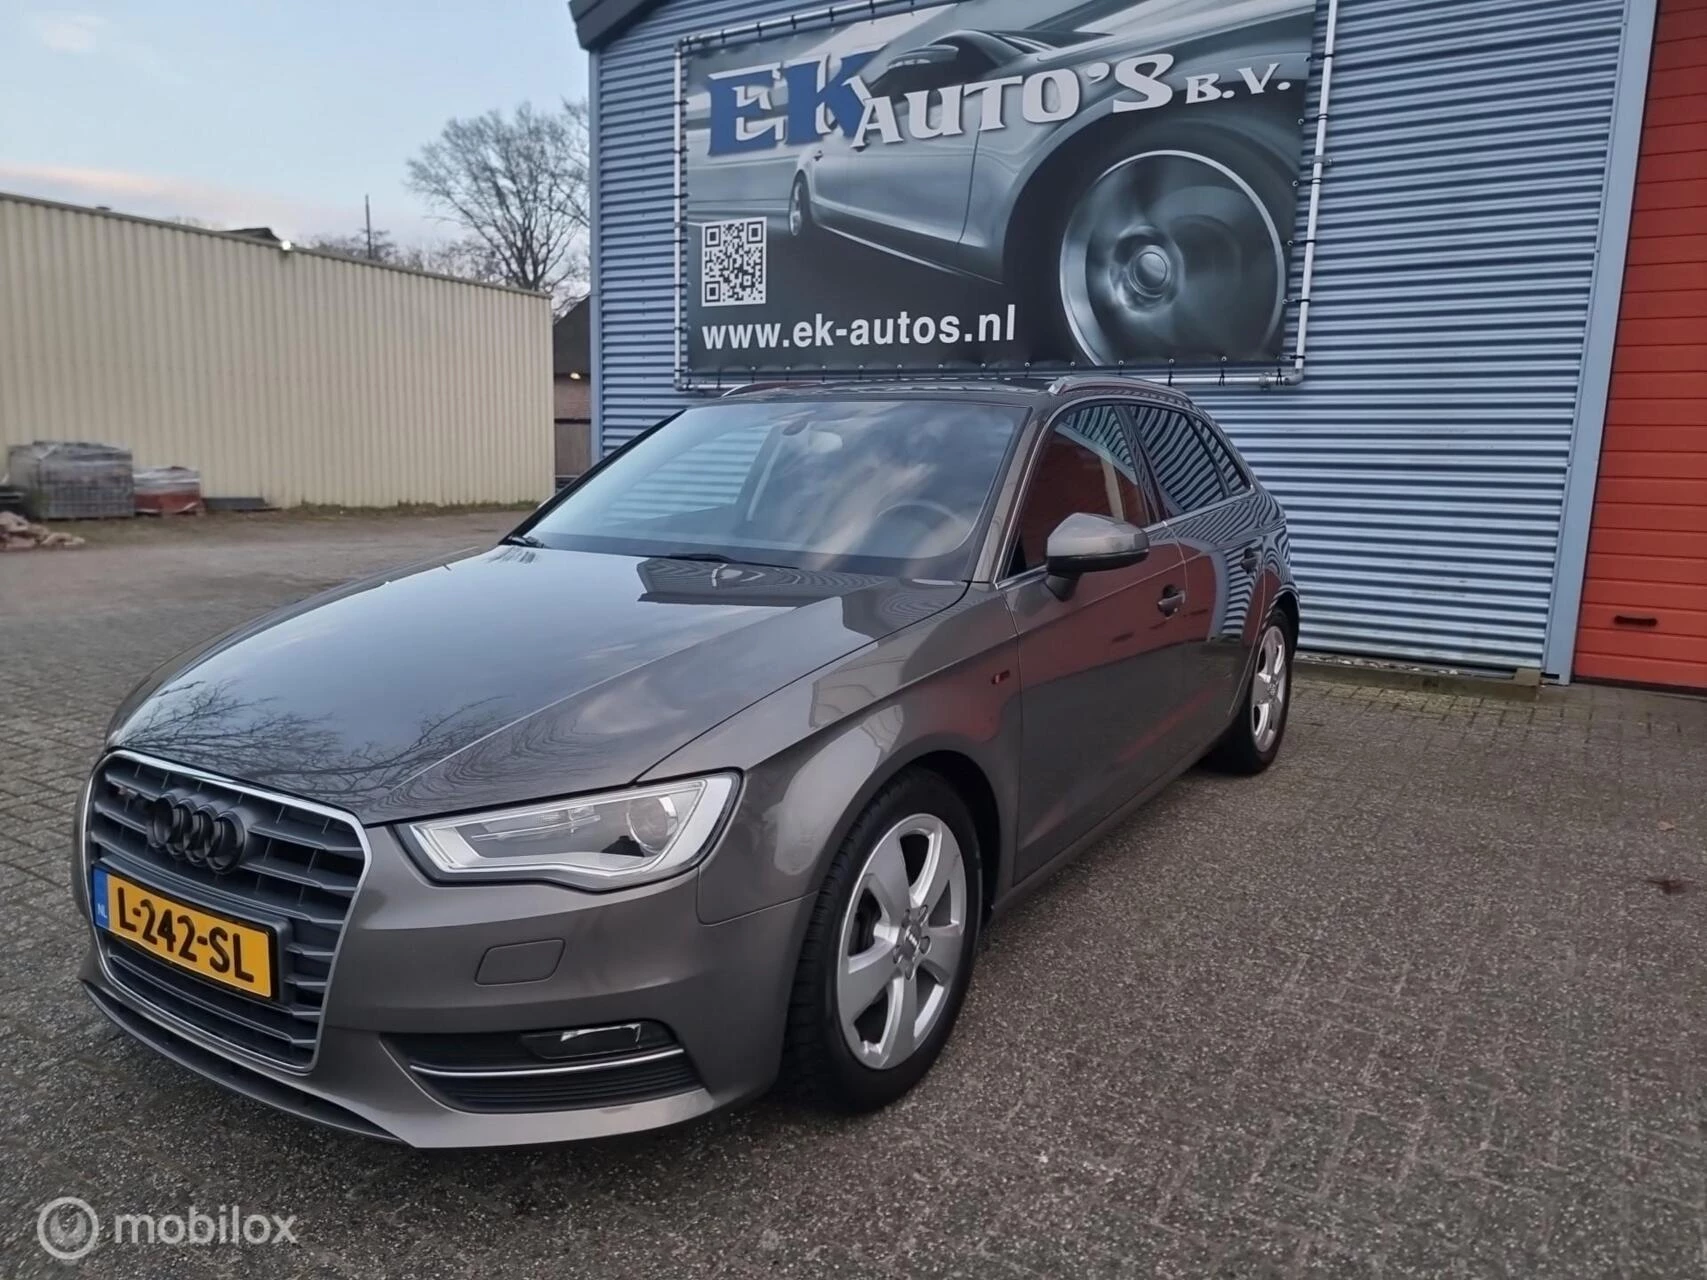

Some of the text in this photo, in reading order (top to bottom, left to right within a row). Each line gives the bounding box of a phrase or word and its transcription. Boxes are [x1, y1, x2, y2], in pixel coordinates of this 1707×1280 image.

[707, 49, 884, 156] EK
[850, 53, 1174, 148] AUTO'S
[701, 304, 1016, 350] www.ek-autos.nl
[117, 887, 254, 983] L-242-SL
